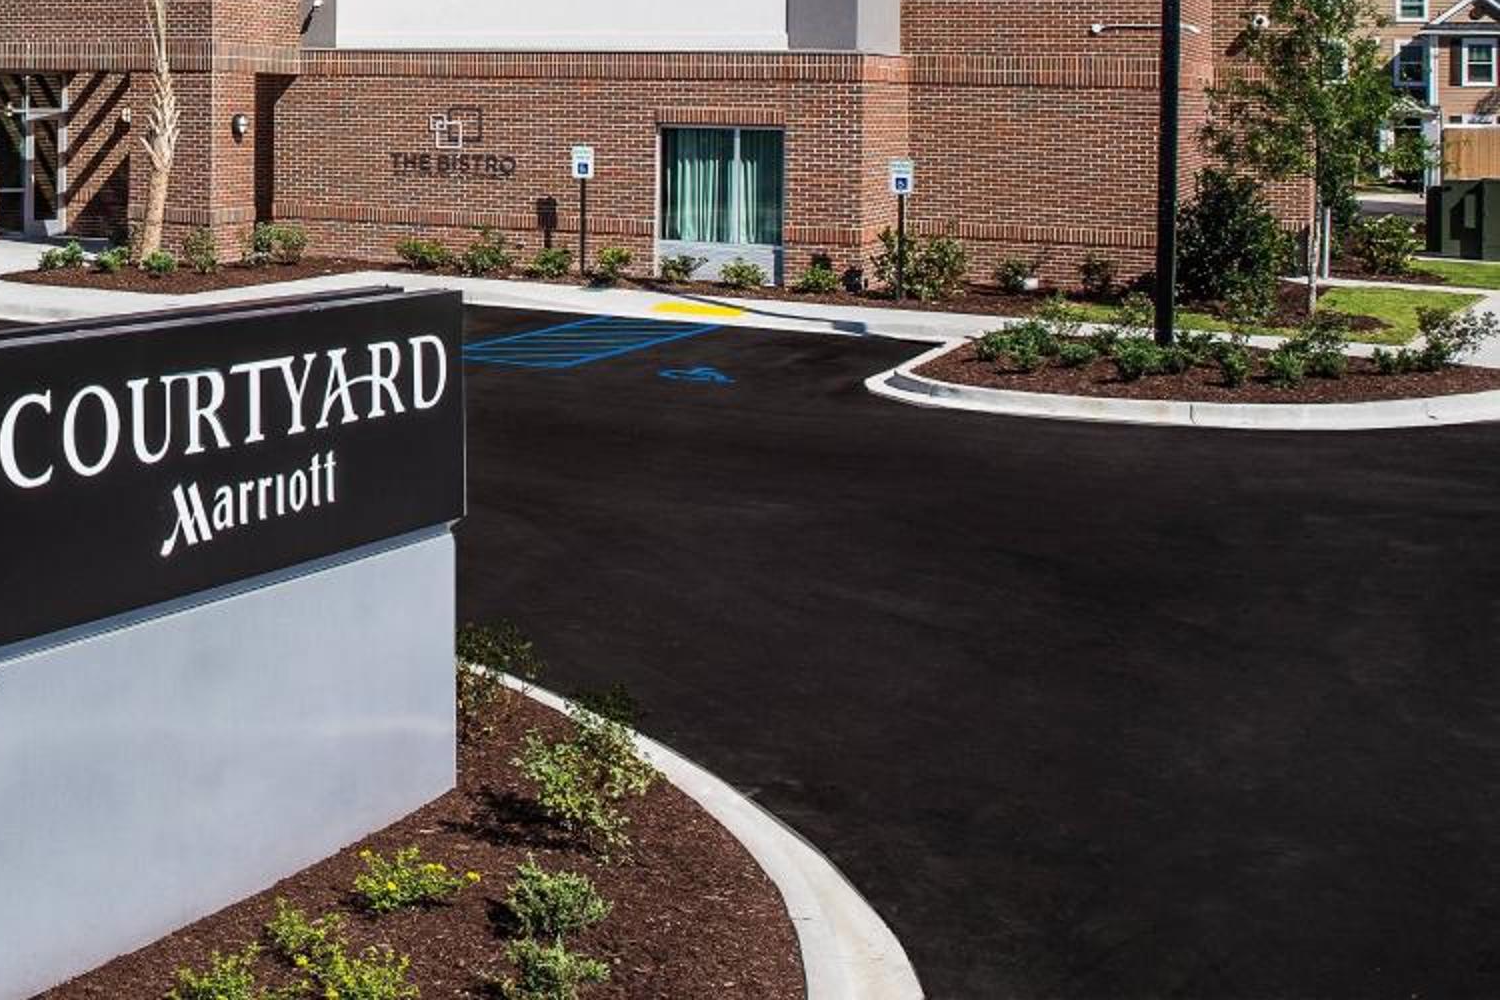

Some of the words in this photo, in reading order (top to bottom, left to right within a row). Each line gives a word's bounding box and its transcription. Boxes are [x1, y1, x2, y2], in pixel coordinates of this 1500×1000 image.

[390, 152, 431, 172] THE
[437, 153, 517, 175] BISTRO
[159, 449, 338, 557] Marriott
